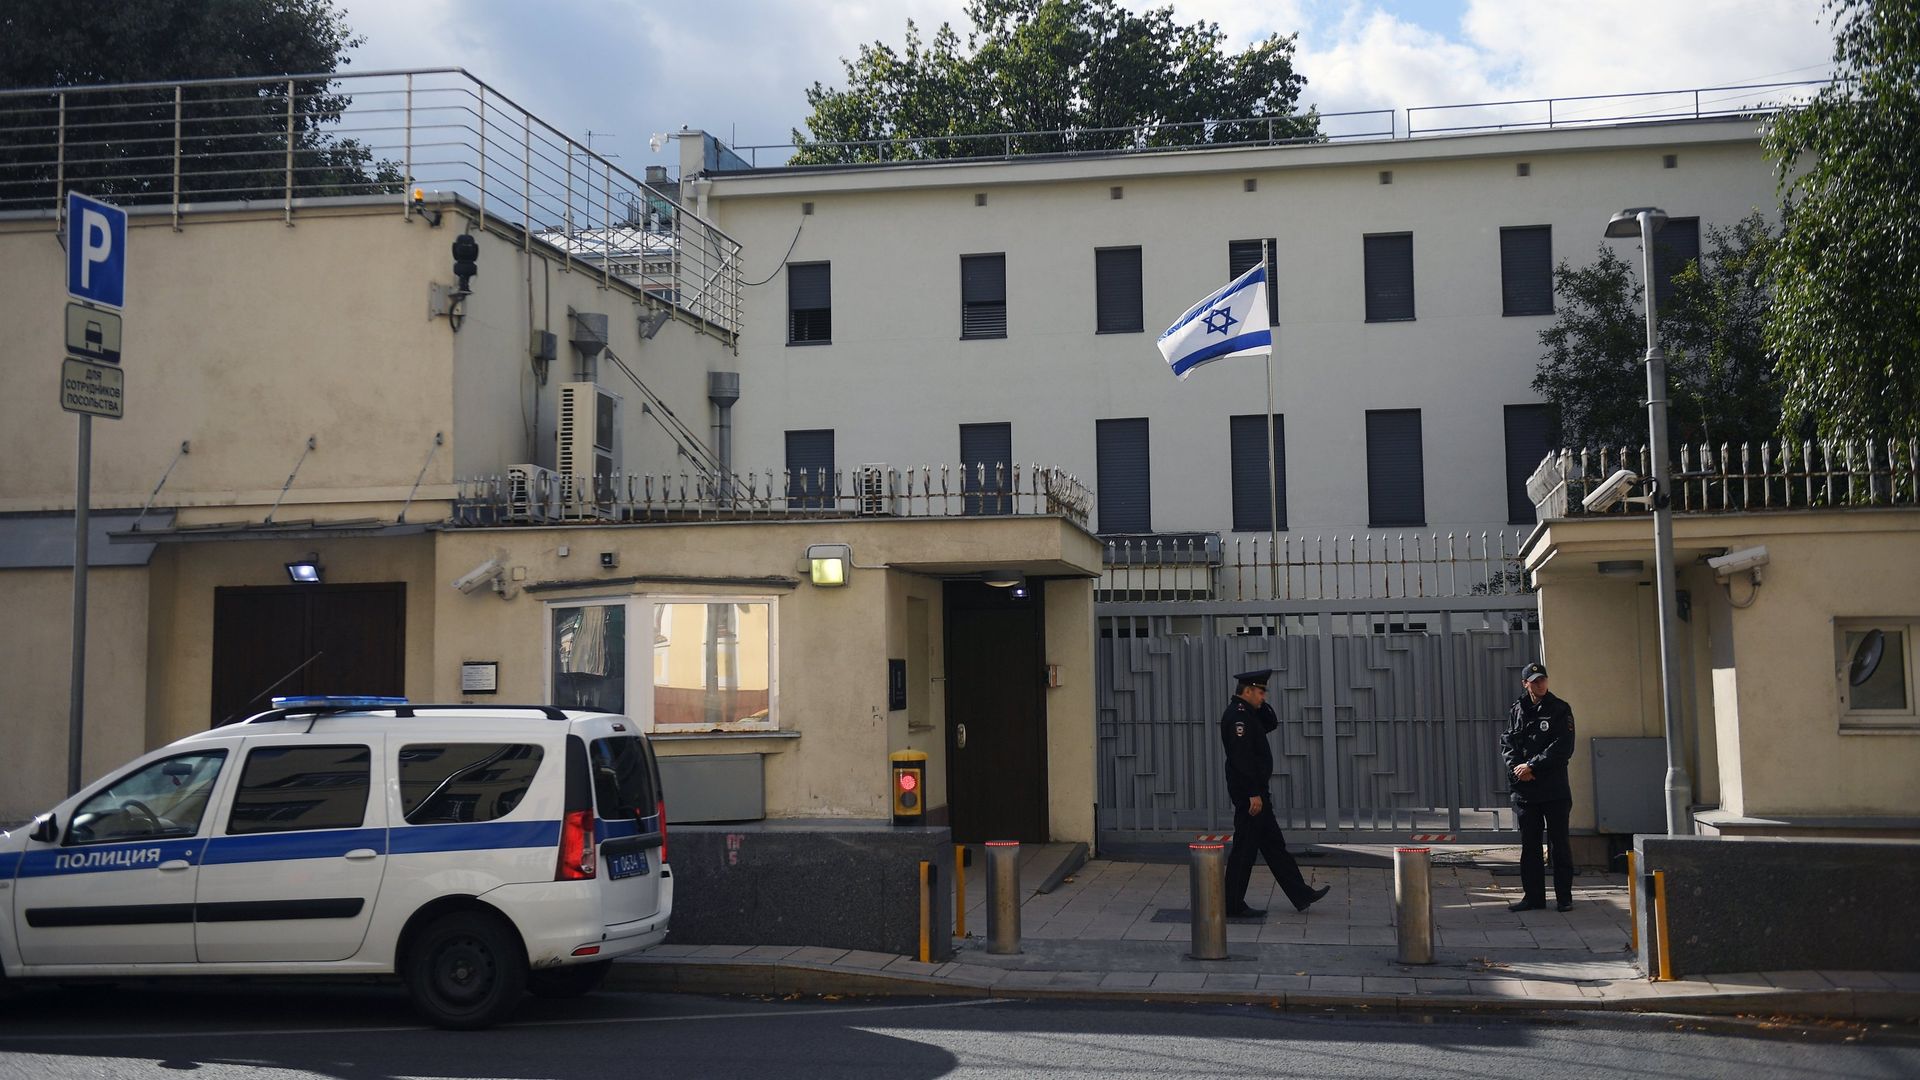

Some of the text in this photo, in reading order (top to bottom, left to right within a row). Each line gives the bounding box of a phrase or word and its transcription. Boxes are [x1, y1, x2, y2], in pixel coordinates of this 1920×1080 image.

[65, 379, 121, 398] СОТРУДНИКОВ
[66, 393, 119, 411] ПОСОЛЬСТВА
[55, 848, 161, 869] ПОЛИЦИЯ
